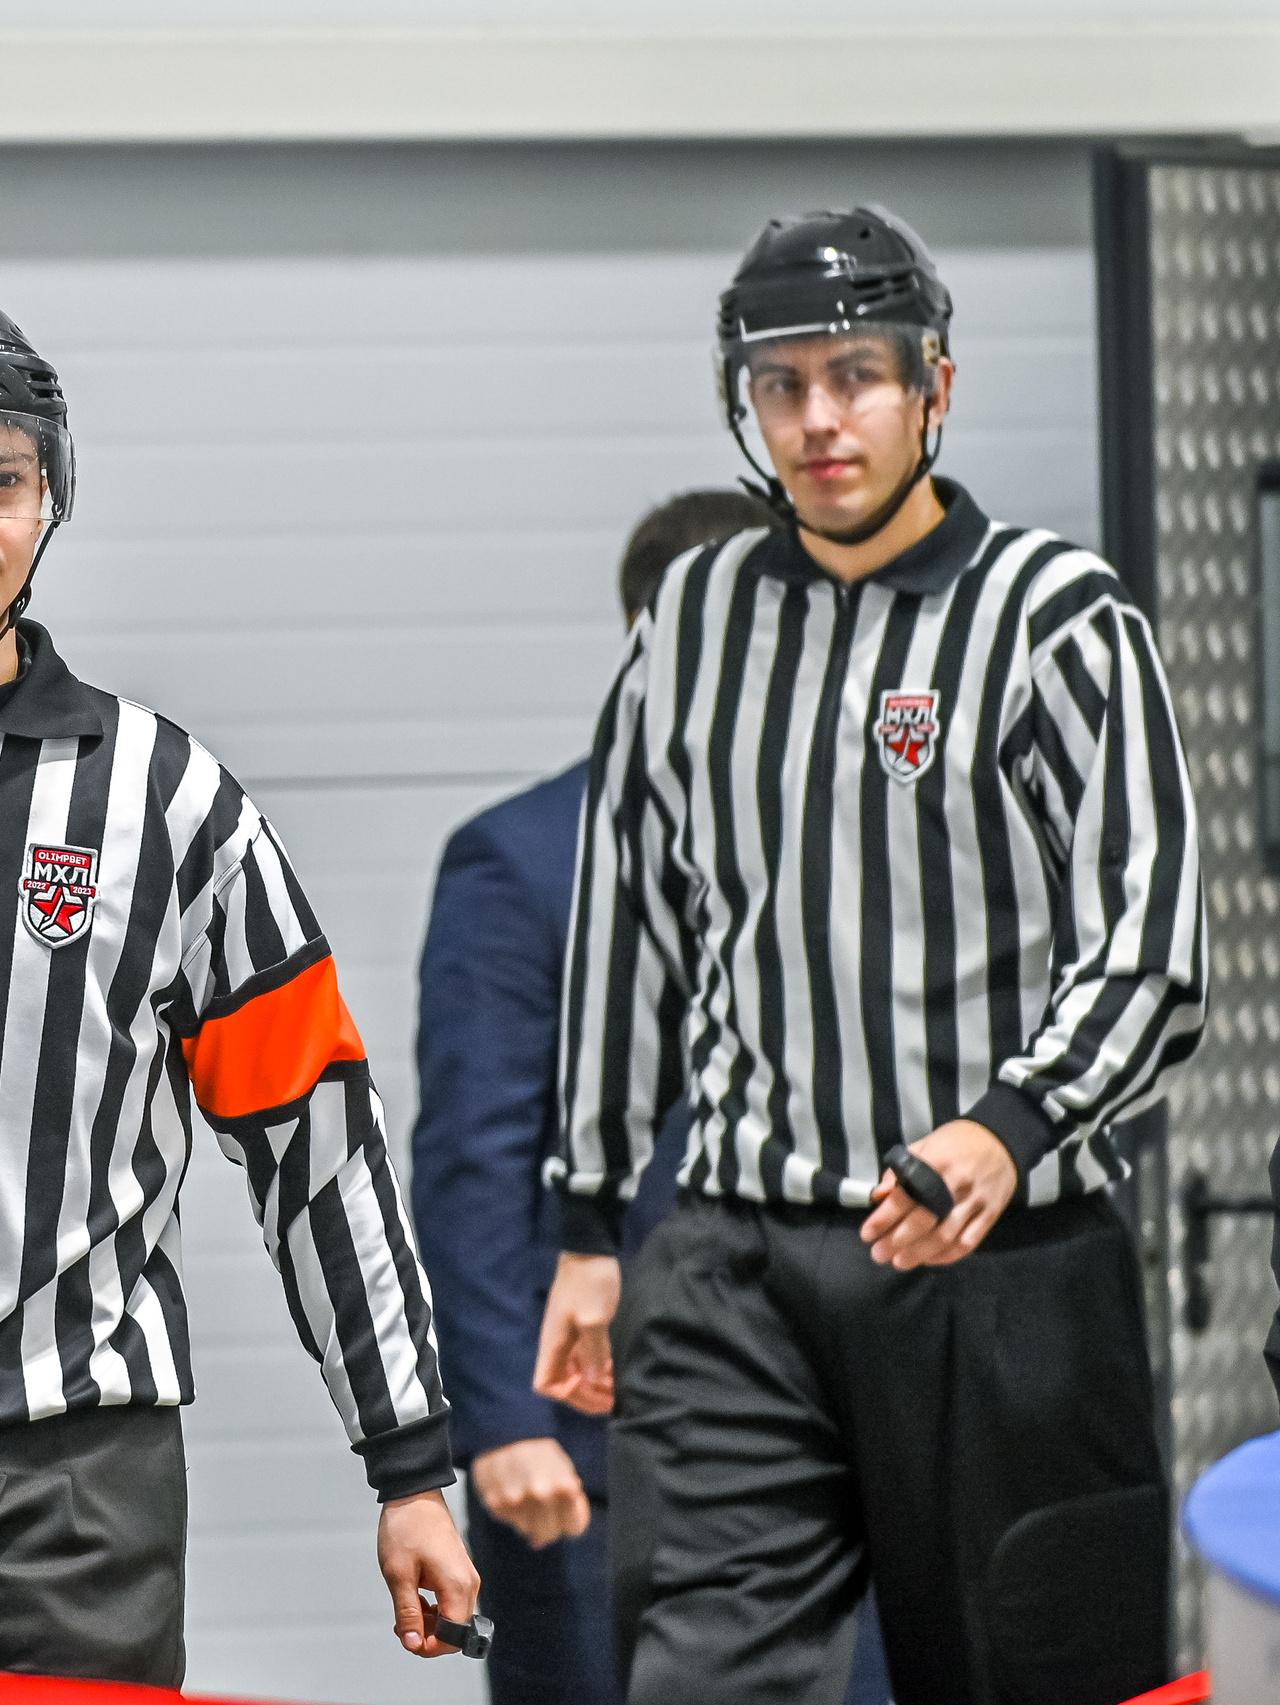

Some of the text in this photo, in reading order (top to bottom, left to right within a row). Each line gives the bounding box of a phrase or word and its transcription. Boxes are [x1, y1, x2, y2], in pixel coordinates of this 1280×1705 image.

[38, 851, 87, 866] OLIMPBET
[33, 861, 89, 886] МХЛ
[27, 880, 92, 896] 2022 2023
